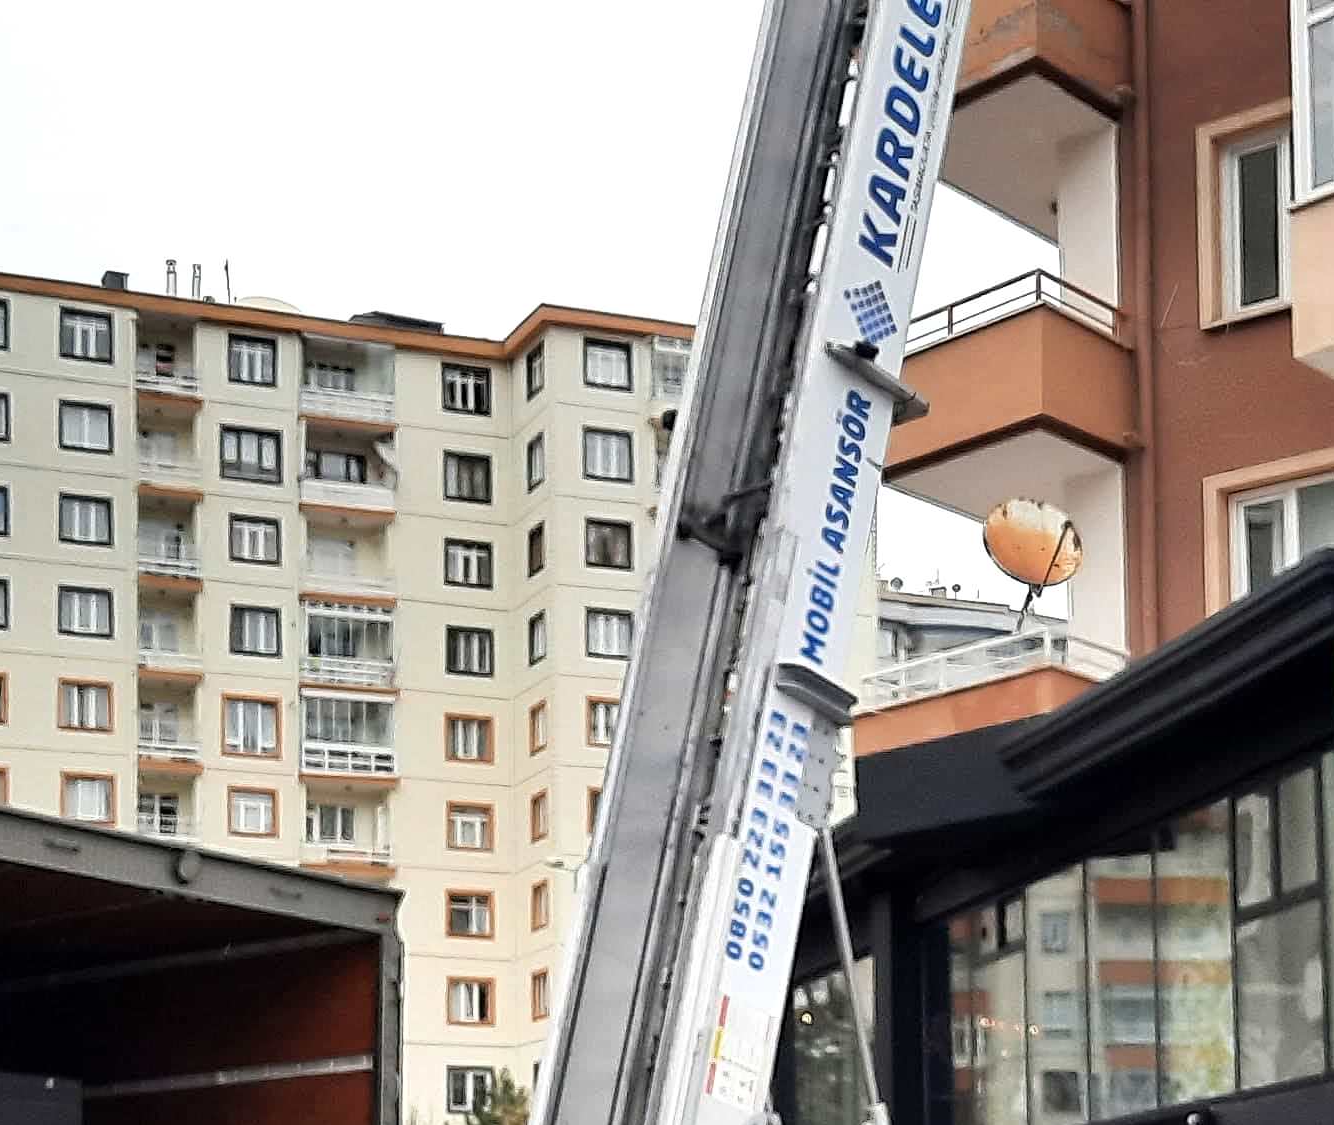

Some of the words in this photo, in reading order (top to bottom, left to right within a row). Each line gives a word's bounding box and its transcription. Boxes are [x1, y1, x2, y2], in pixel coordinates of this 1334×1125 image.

[858, 0, 943, 268] KARDELE
[799, 559, 840, 666] MOBİL
[821, 388, 872, 555] ASANSÖR
[725, 877, 755, 960] 0850
[742, 806, 768, 869] 223
[748, 888, 777, 971] 0532
[766, 818, 790, 881] 155
